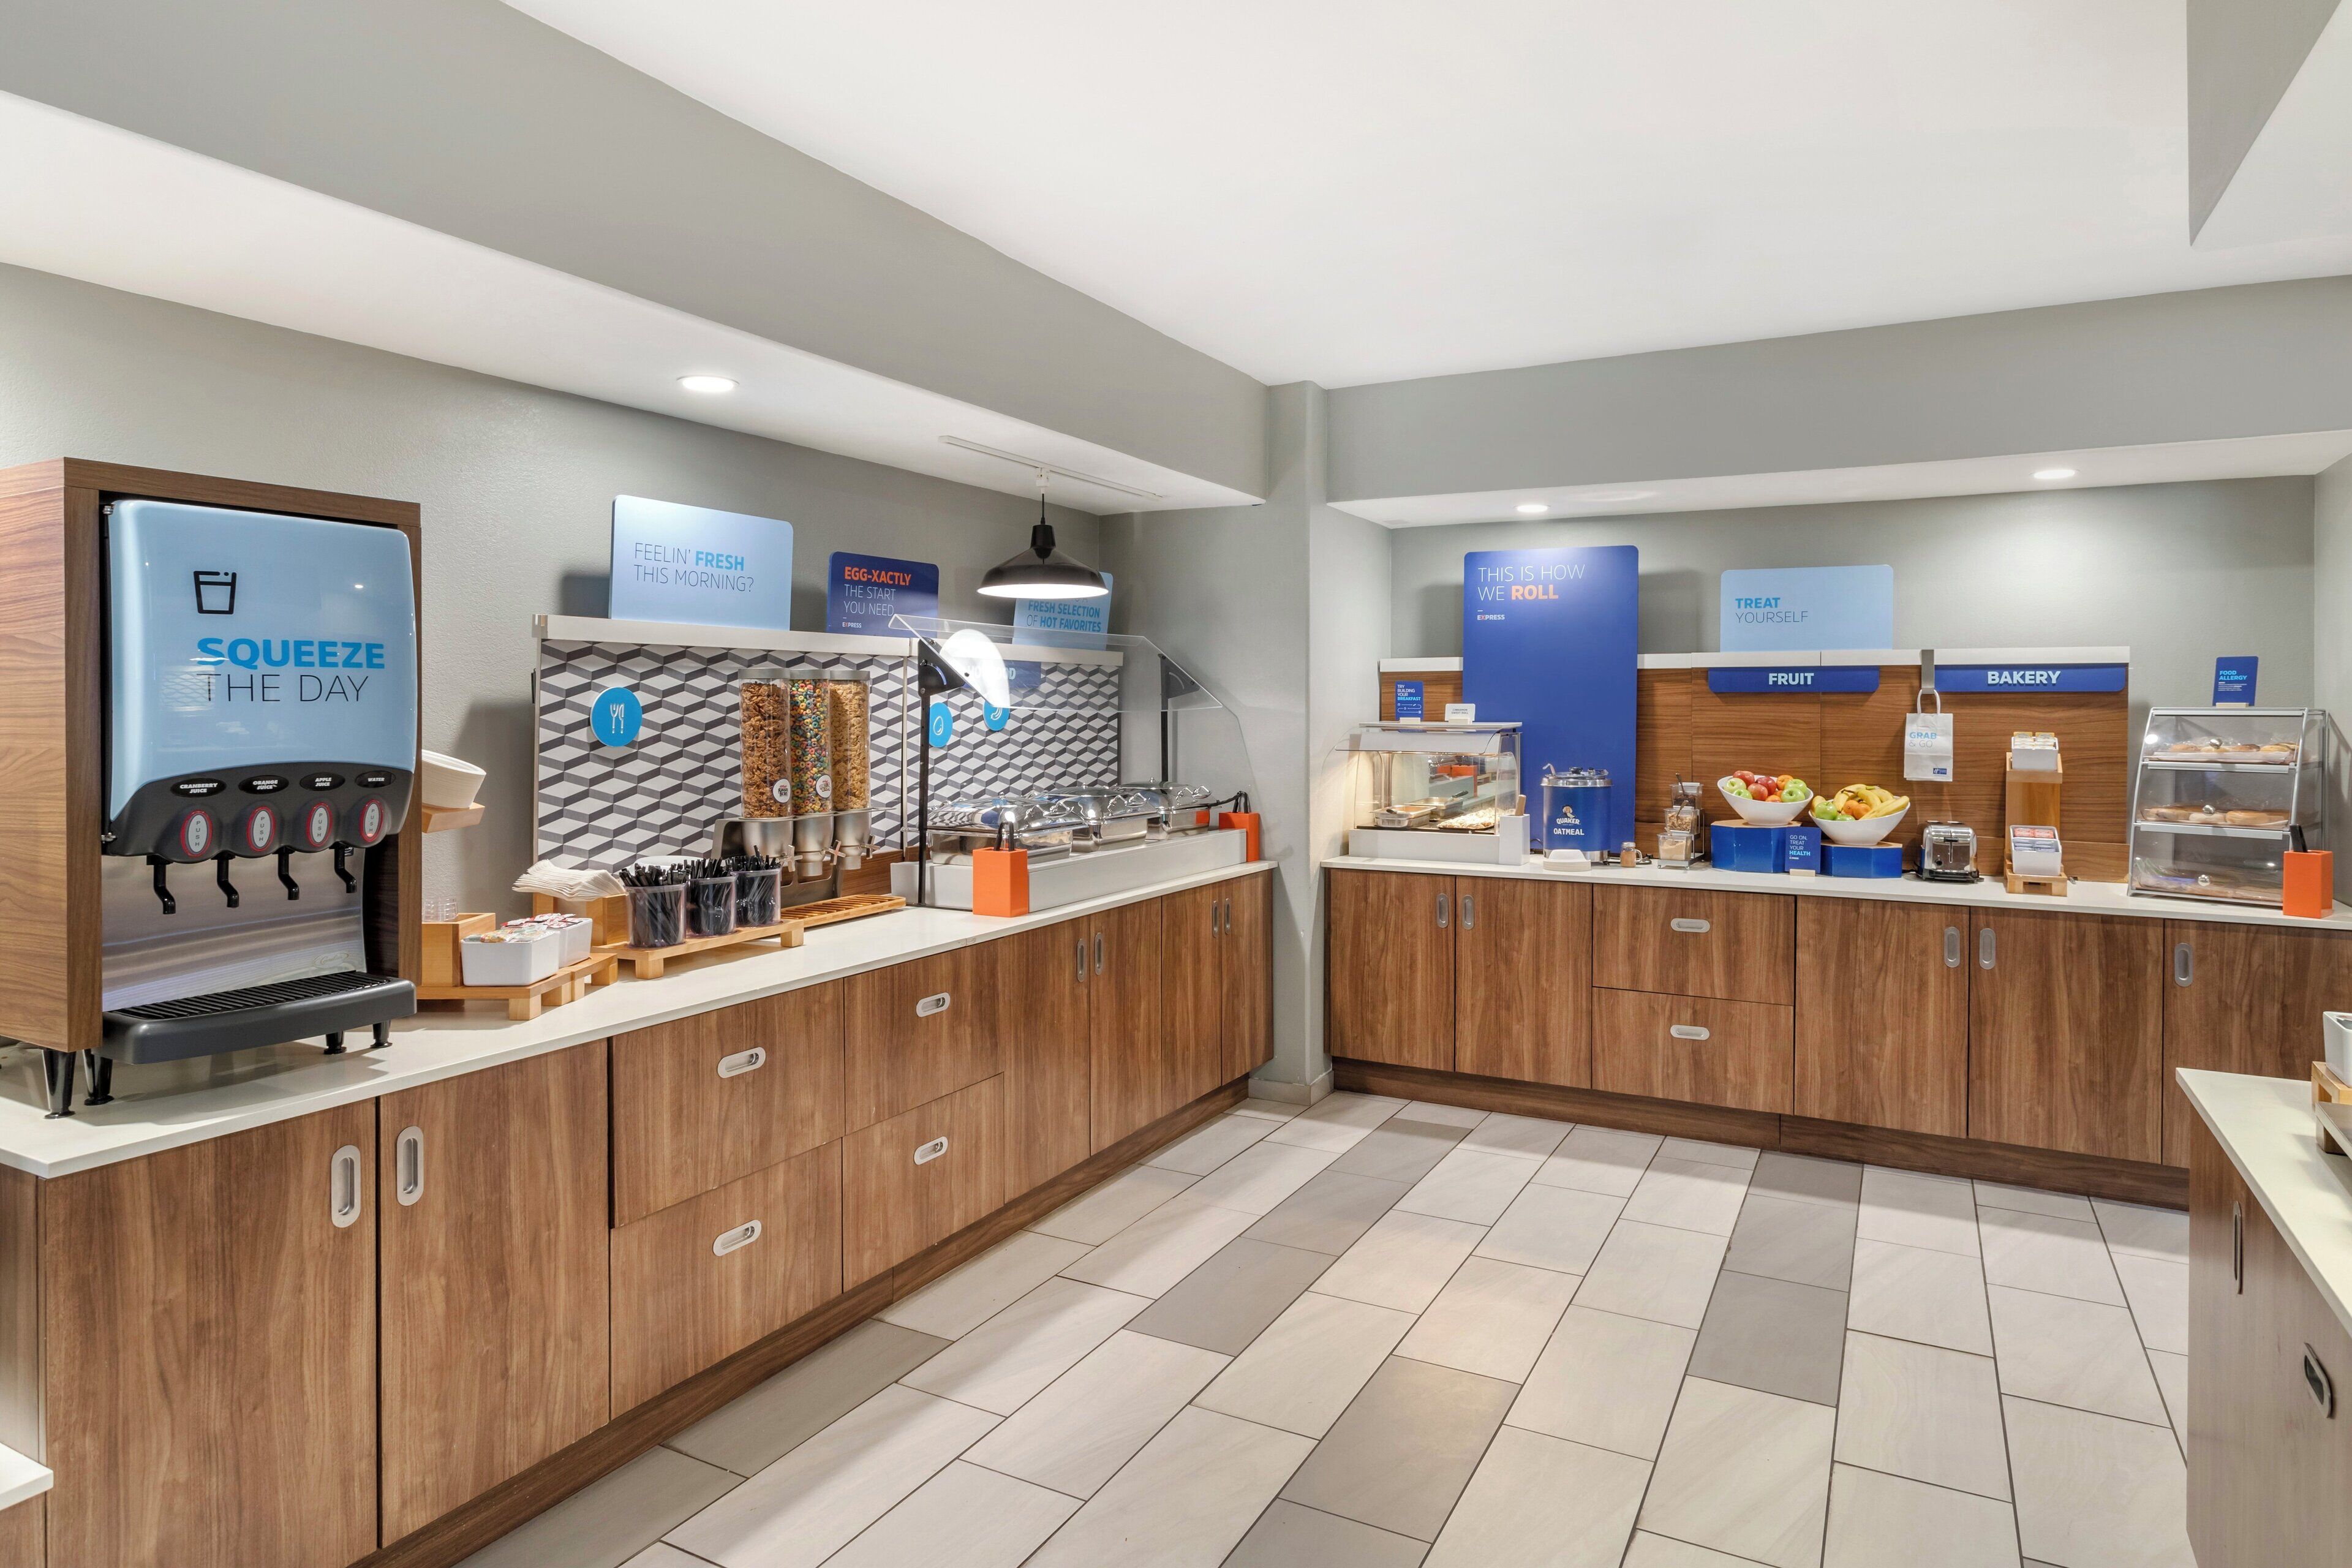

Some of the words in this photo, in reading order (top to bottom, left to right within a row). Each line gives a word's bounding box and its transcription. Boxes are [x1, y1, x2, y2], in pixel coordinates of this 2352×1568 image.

[635, 542, 690, 565] FEELIN'
[695, 550, 745, 571] FRESH
[633, 564, 669, 584] THIS
[674, 569, 755, 592] MORNING?
[844, 566, 911, 586] EGG-XACTLY
[1477, 567, 1514, 582] THIS
[1521, 566, 1534, 581] IS
[1541, 564, 1585, 580] HOW
[844, 584, 864, 598] THE
[867, 586, 896, 600] START
[1477, 586, 1504, 601] WE
[1511, 584, 1559, 600] ROLL
[843, 601, 865, 614] YOU
[869, 603, 894, 616] NEED
[1028, 600, 1055, 614] FRESH
[1057, 603, 1101, 618] SELECTION
[1735, 597, 1781, 609] TREAT
[1027, 614, 1038, 627] OF
[1039, 616, 1058, 628] HOT
[1059, 617, 1102, 632] FAVORITES
[1735, 611, 1809, 624] YOURSELF
[197, 638, 385, 669] SQUEEZE
[1768, 673, 1814, 685] FRUIT
[1987, 671, 2061, 685] BAKERY
[196, 674, 281, 702] THE
[300, 674, 369, 702] DAY
